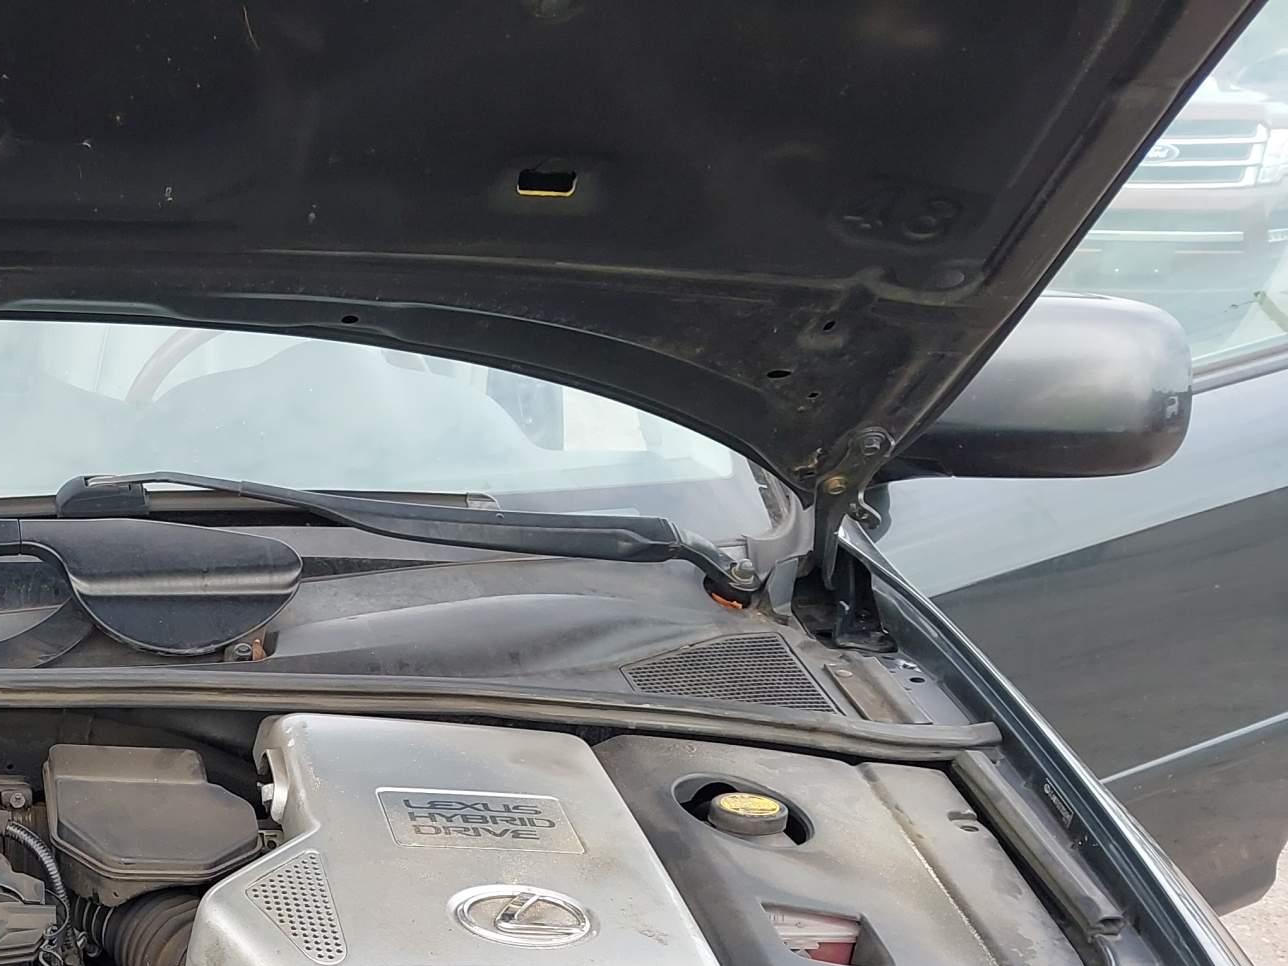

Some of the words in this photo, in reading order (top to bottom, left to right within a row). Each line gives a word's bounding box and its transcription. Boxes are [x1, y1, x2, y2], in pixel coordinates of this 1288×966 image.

[403, 799, 542, 815] LEXUS
[407, 811, 556, 828] HYBRID
[412, 825, 540, 840] DRIVE
